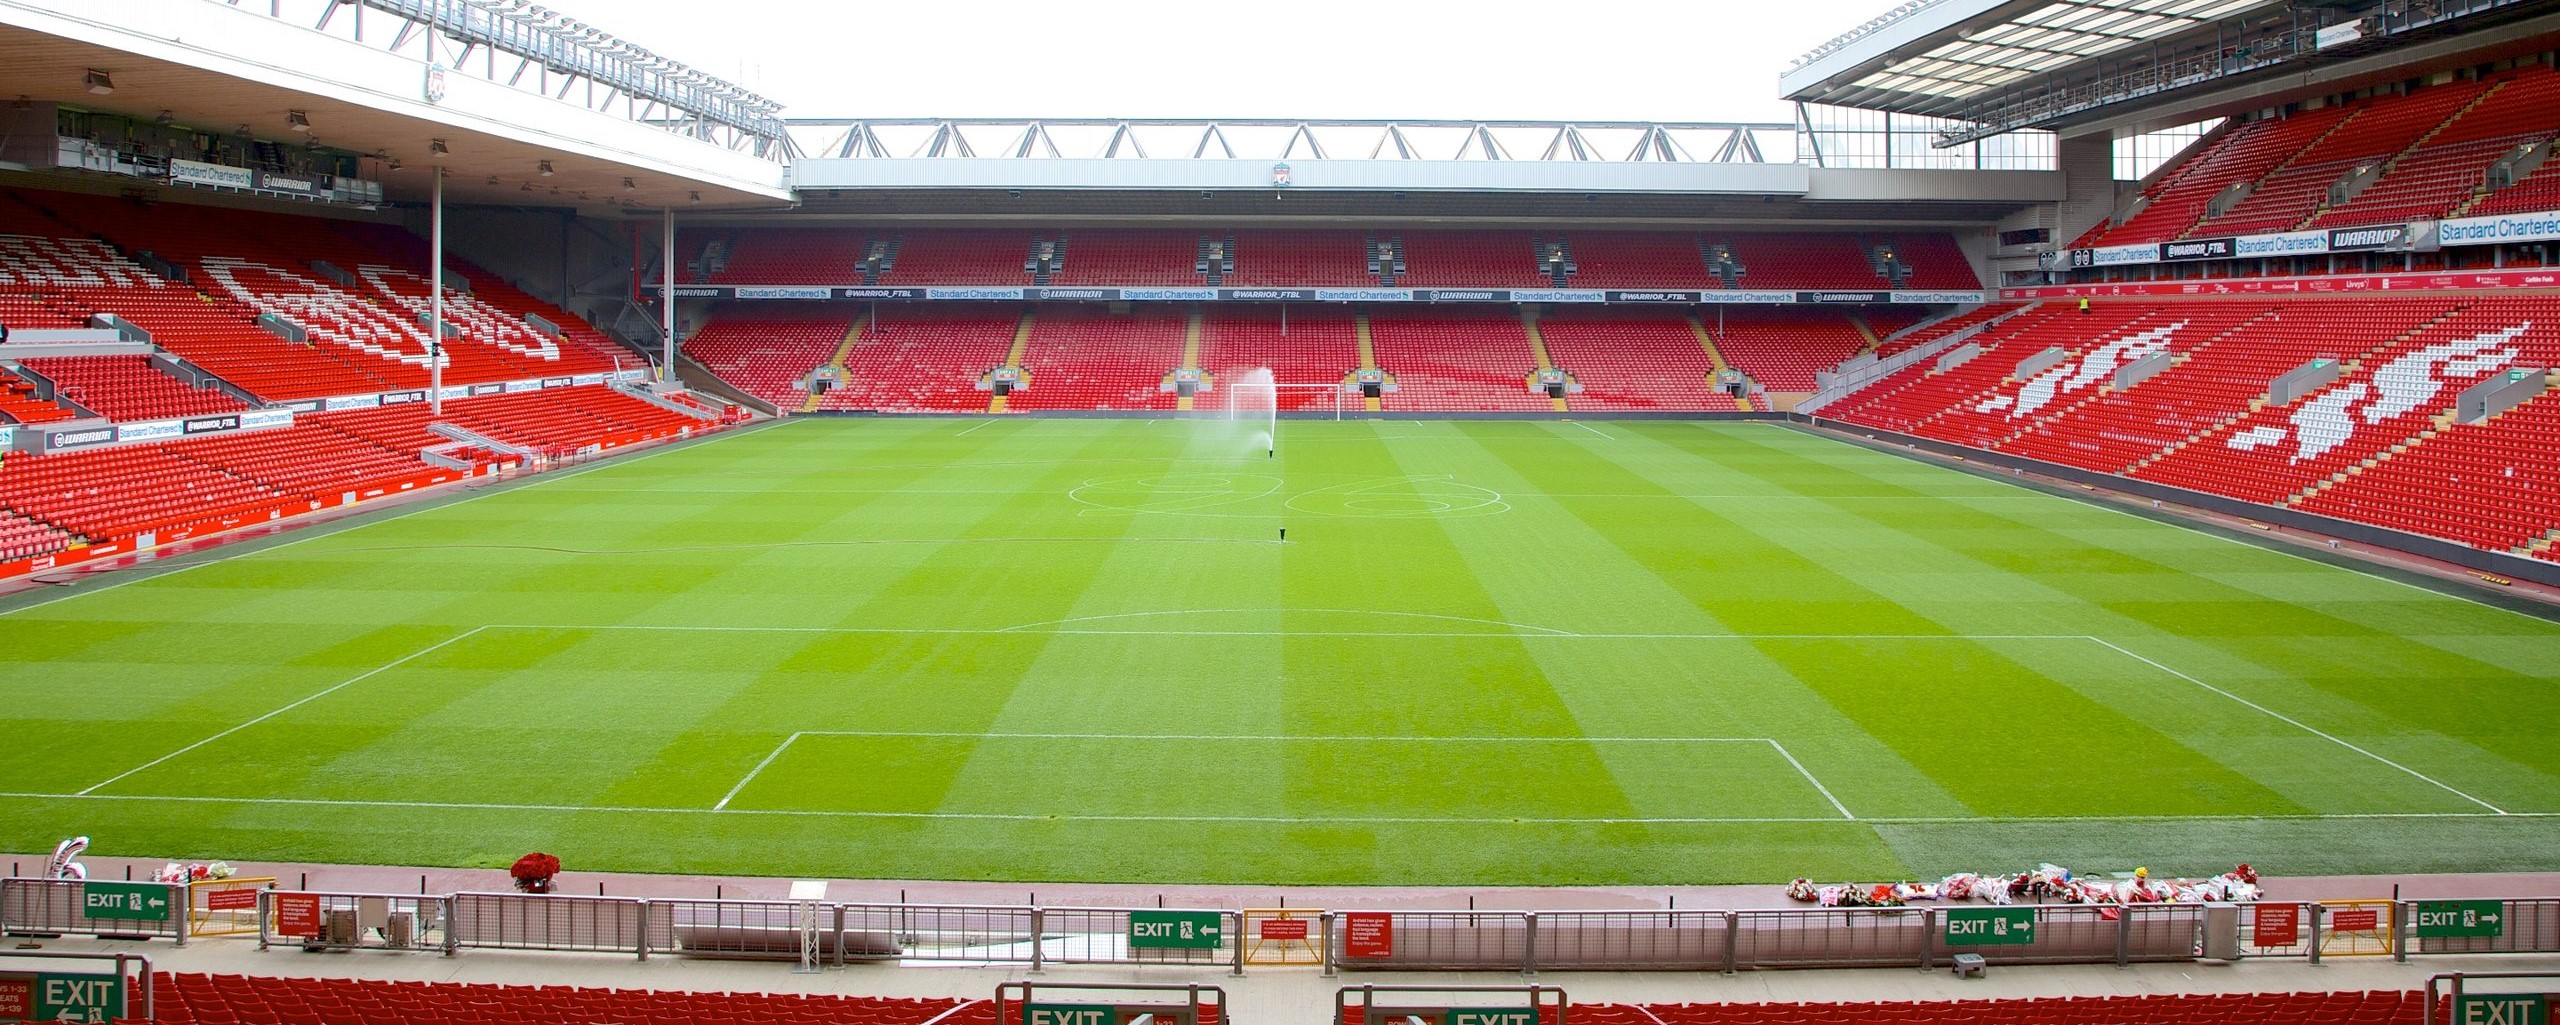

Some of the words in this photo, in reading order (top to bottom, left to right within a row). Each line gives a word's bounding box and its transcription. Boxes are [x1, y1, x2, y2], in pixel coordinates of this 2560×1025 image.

[171, 162, 206, 177] Standard
[209, 168, 245, 183] Chartered
[270, 177, 312, 191] WARRIOR
[2441, 220, 2496, 240] Standard
[2168, 243, 2226, 257] @WARRIOR_FTBL
[2237, 240, 2274, 253] Standard
[2275, 236, 2318, 250] Chartered
[2094, 250, 2120, 262] Standard
[2122, 248, 2152, 261] Chartered
[740, 289, 778, 298] Standard
[780, 289, 820, 298] Chartered
[845, 289, 912, 298] @WARRIOR_FTBL
[931, 290, 968, 298] Standard
[970, 290, 1011, 298] Chartered
[1051, 290, 1103, 298] WARRIOR
[1124, 290, 1163, 299] Standard
[1165, 290, 1206, 299] Chartered
[1232, 290, 1300, 299] @WARRIOR_FTBL
[1320, 291, 1358, 299] Standard
[1360, 291, 1401, 299] Chartered
[1514, 292, 1552, 300] Standard
[1554, 292, 1595, 300] Chartered
[1619, 293, 1687, 301] @WARRIOR_FTBL
[1705, 293, 1742, 301] Standard
[1744, 293, 1784, 301] Chartered
[1822, 293, 1874, 301] WARRIOR
[1894, 293, 1932, 302] Standard
[1933, 293, 1973, 302] Chartered
[65, 431, 112, 444] WARRIOR
[120, 427, 147, 439] Standard
[149, 424, 179, 436] Chartered
[87, 893, 124, 907] EXIT
[2420, 912, 2457, 926] EXIT
[1134, 922, 1174, 937] EXIT
[1949, 920, 1988, 934] EXIT
[46, 980, 114, 1006] EXIT
[1032, 1010, 1105, 1025] EXIT
[2465, 1000, 2536, 1025] EXIT
